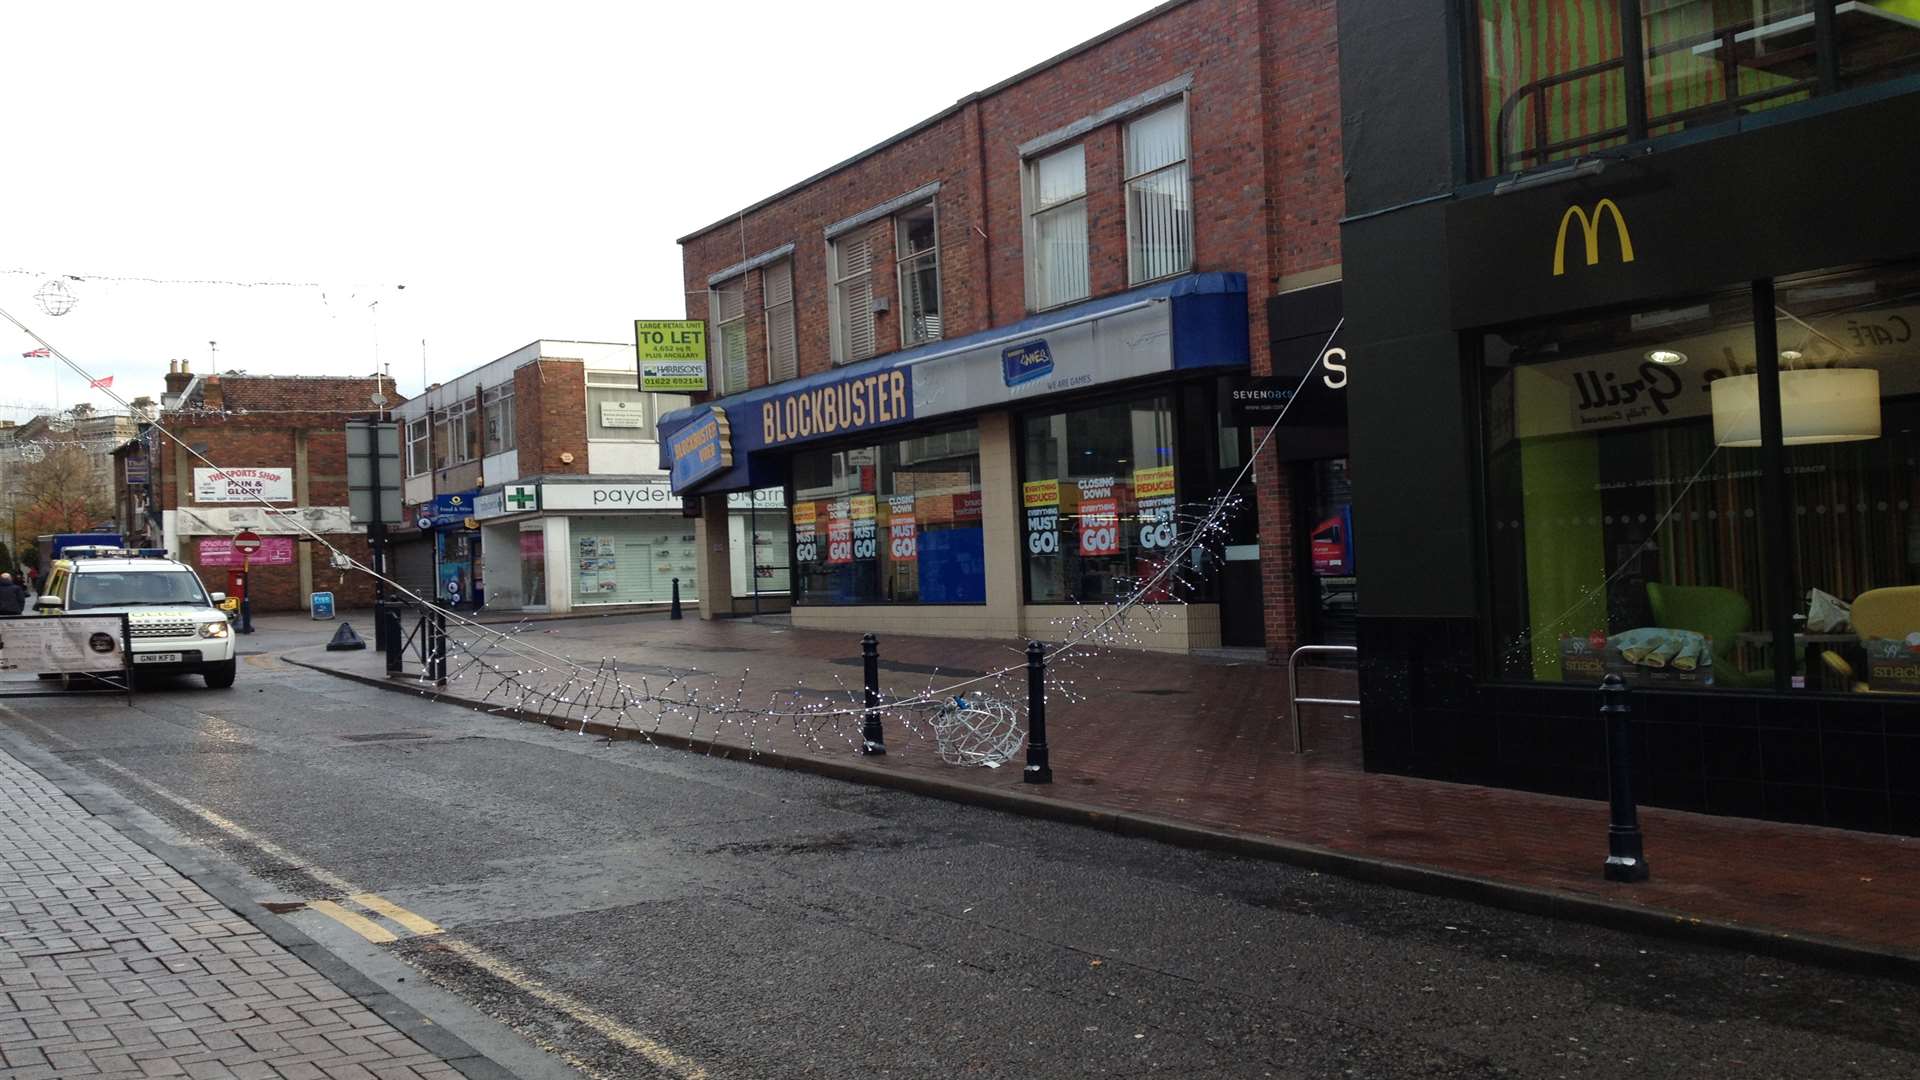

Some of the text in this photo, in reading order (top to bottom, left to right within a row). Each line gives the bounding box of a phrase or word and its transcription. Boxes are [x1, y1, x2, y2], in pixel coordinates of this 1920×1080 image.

[640, 331, 702, 344] TO LET
[657, 365, 704, 374] HARRISONS
[1047, 381, 1057, 390] WE
[1057, 379, 1069, 388] ARE
[763, 374, 905, 443] BLOCKBUSTER
[208, 469, 282, 484] THE SPORTS SHOP
[1078, 477, 1115, 490] CLOSING
[227, 480, 263, 488] PAIN &
[1137, 480, 1174, 494] REDUCED
[227, 487, 263, 496] GLORY
[1083, 487, 1111, 500] DOWN
[889, 495, 914, 506] CLOSING
[892, 503, 912, 514] DOWN
[1139, 505, 1176, 524] MUST
[1028, 515, 1058, 531] MUST
[1082, 512, 1115, 528] MUST
[796, 531, 815, 543] MUST
[832, 529, 849, 542] MUST
[854, 526, 875, 540] MUST
[892, 523, 915, 537] MUST
[1140, 523, 1177, 550] GO!
[1029, 530, 1059, 553] GO!
[1082, 528, 1117, 551] GO!
[796, 543, 817, 561] GO!
[830, 542, 851, 560] GO!
[854, 539, 876, 558] GO!
[892, 537, 917, 557] GO!
